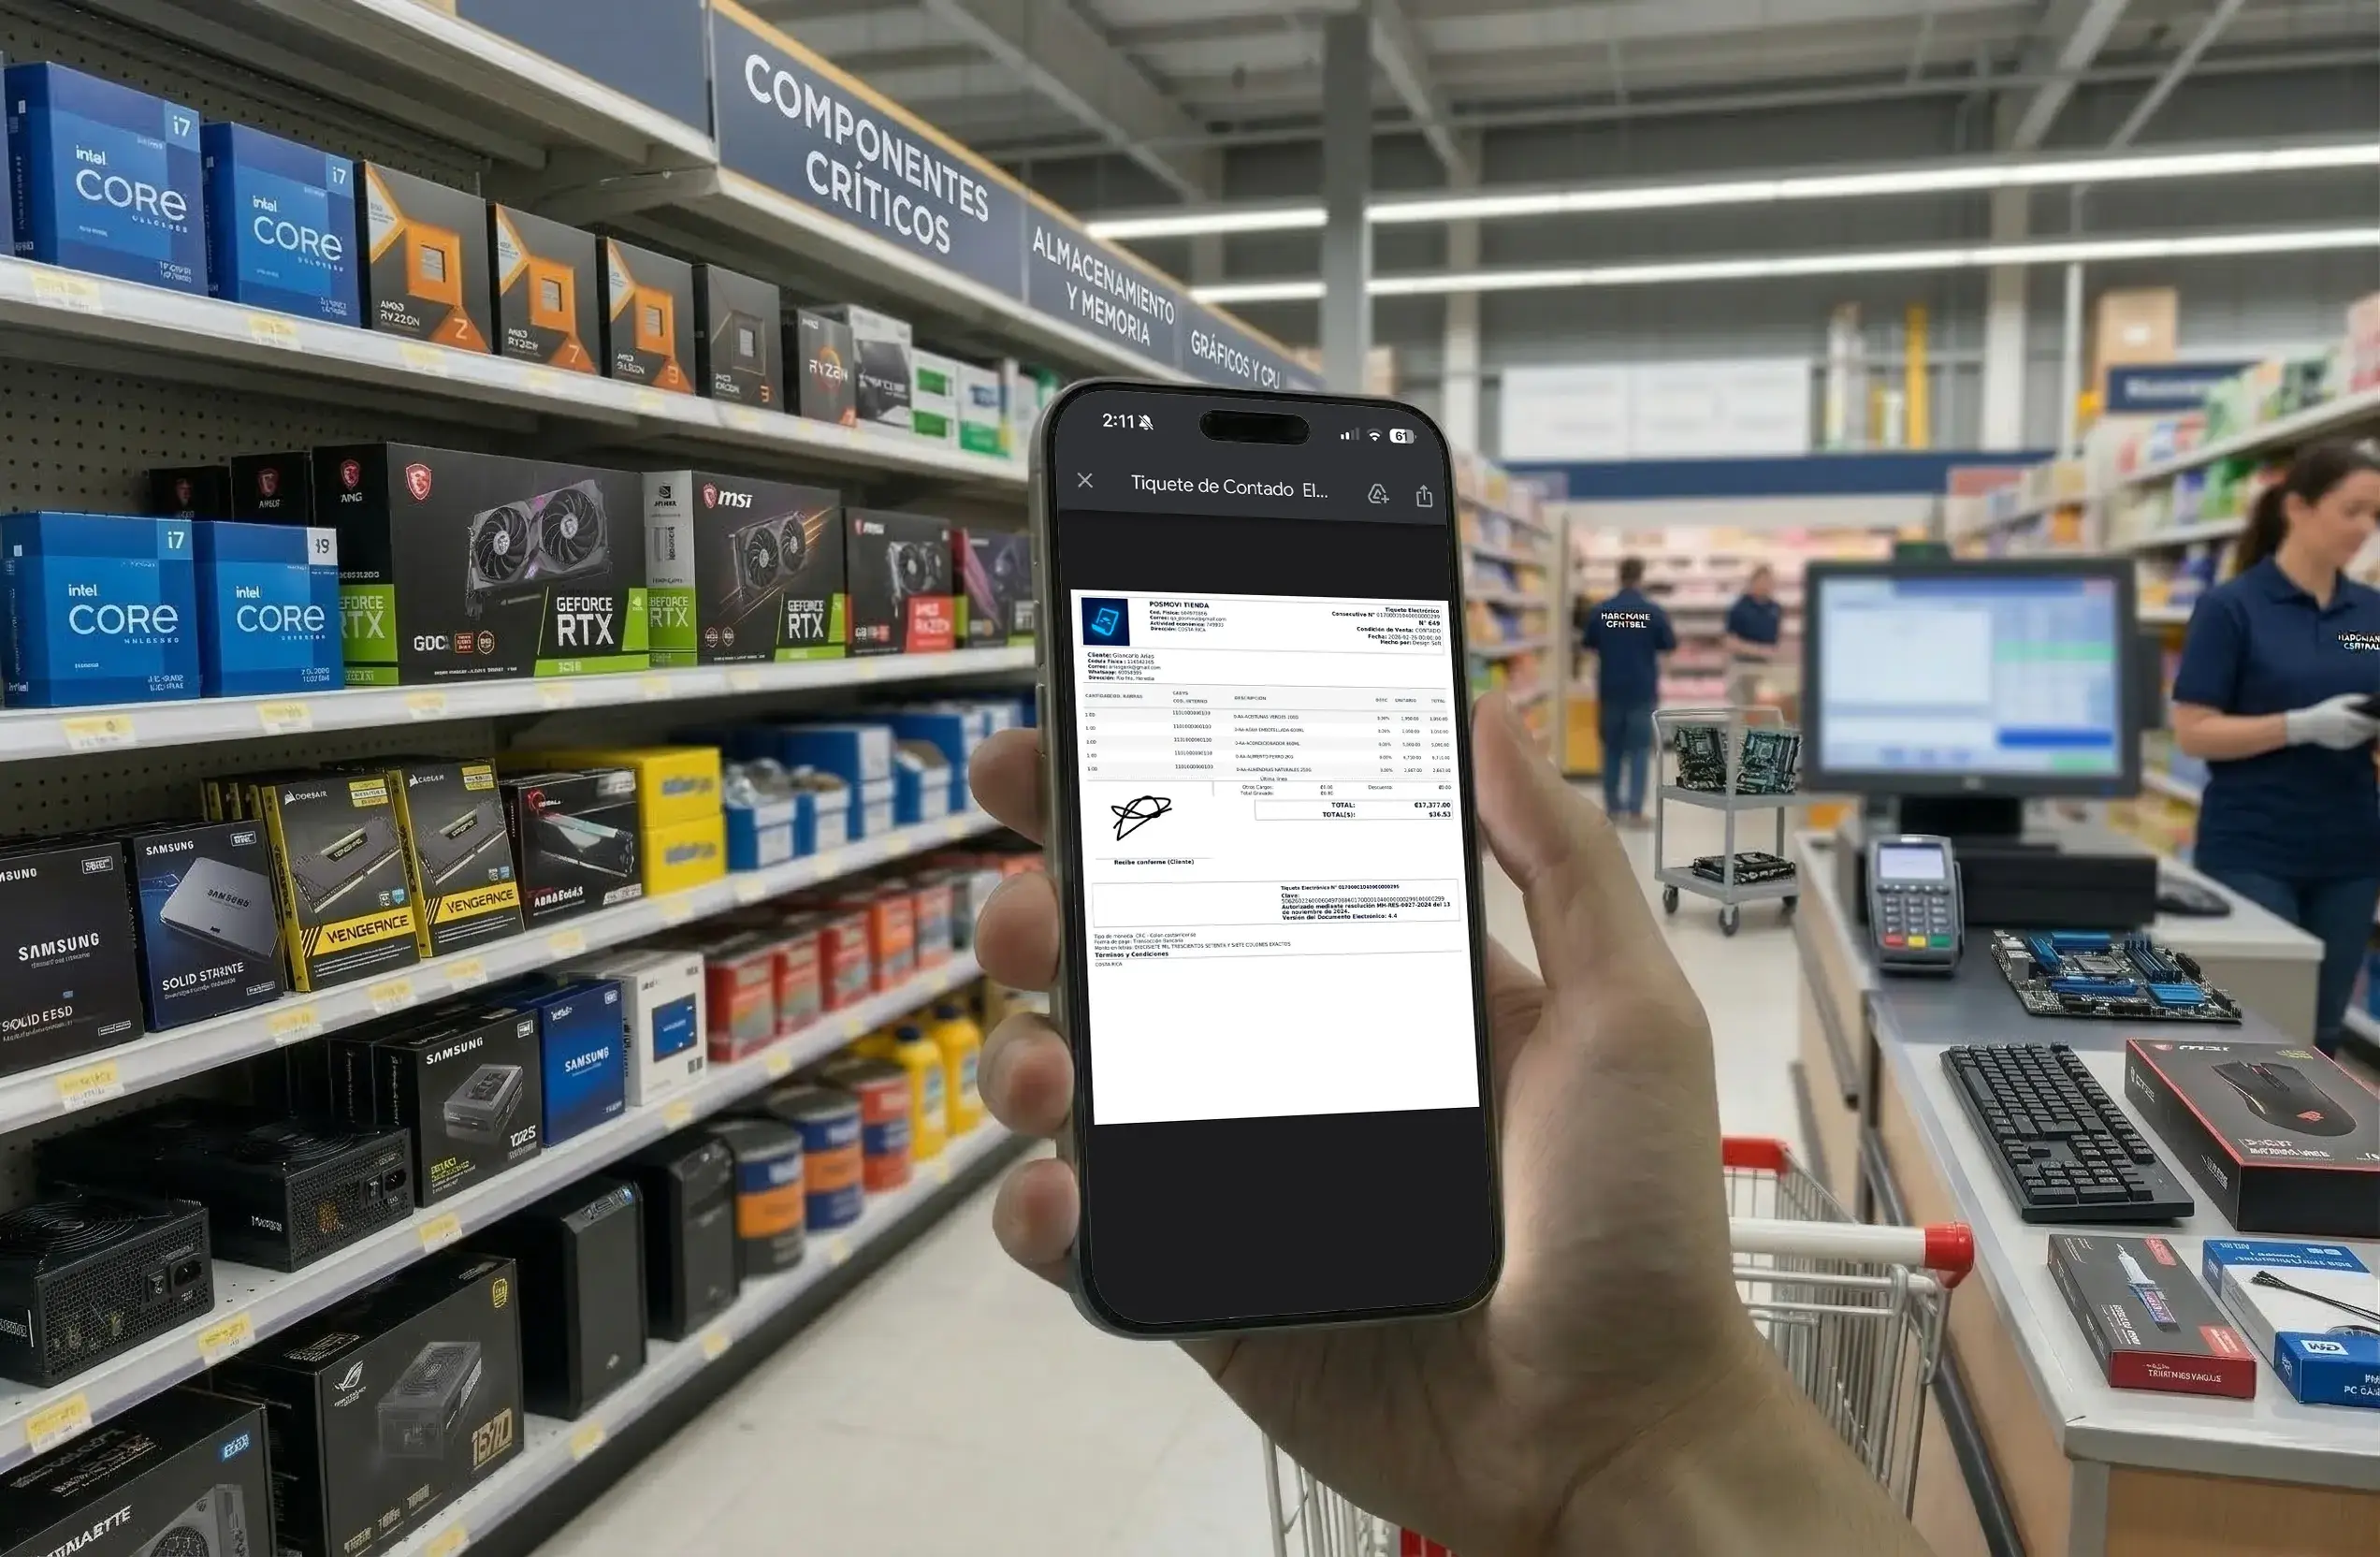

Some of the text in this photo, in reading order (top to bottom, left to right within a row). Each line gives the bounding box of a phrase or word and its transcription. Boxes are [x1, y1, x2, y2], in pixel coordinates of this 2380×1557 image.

[173, 116, 191, 137] i7
[744, 53, 990, 224] COMPONENTES
[332, 167, 346, 184] i7
[805, 149, 951, 255] CRÍTICOS
[1032, 226, 1175, 327] ALMACENAMIENTO
[1067, 282, 1151, 346] Y MEMORIA
[569, 344, 580, 362] 7
[1191, 329, 1280, 389] GRÁFICOS Y CPU
[1103, 414, 1408, 443] 2:11 61
[1131, 474, 1328, 499] Tiquete de Contado El...
[718, 490, 752, 509] msi
[167, 531, 184, 549] i7
[68, 584, 97, 597] intel
[236, 586, 260, 599] intel
[339, 595, 384, 610] EFORCE
[557, 597, 613, 612] GEFORCE
[650, 607, 689, 628] RTX
[788, 614, 824, 639] RTX
[558, 613, 614, 647] RTX
[146, 840, 195, 856] SAMSUNG
[446, 889, 515, 914] VENGEANCE
[327, 915, 409, 943] VENGEANCE
[19, 932, 100, 962] SAMSUNG
[162, 974, 197, 991] SOLID
[426, 1037, 484, 1065] SAMSUNG
[2344, 1386, 2358, 1394] PC
